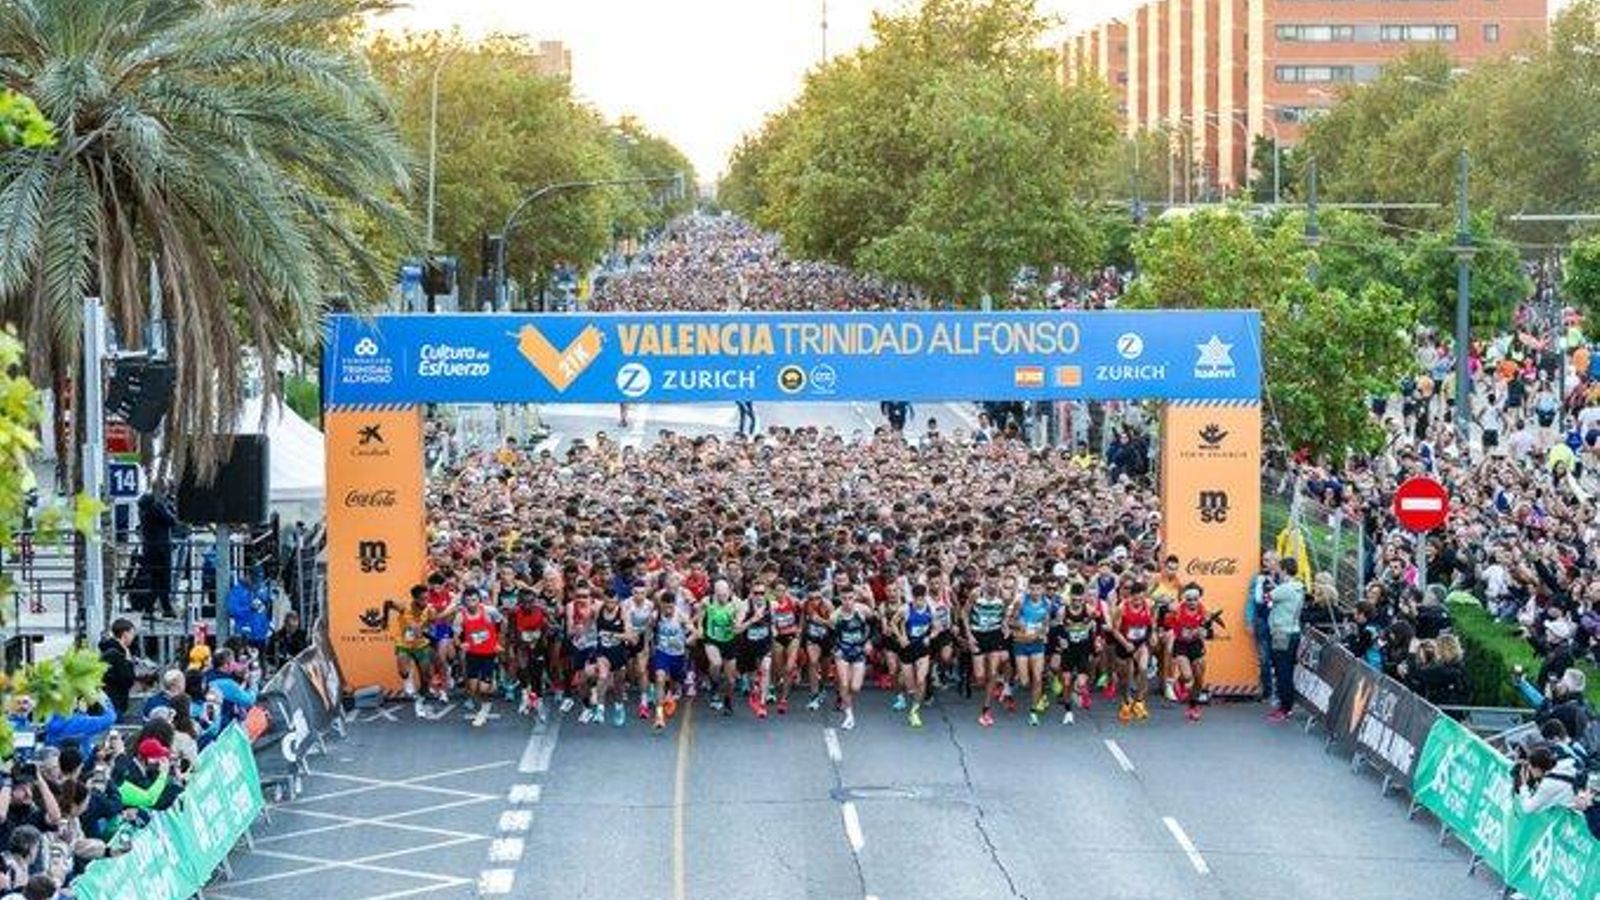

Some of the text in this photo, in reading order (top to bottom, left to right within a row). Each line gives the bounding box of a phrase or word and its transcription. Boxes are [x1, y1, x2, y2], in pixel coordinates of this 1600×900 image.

[617, 321, 1081, 356] VALENCIA TRINIDAD ALFONSO
[420, 344, 475, 360] Cultura
[559, 341, 589, 379] 21K
[342, 365, 393, 374] TRINIDAD
[418, 360, 490, 376] Esfuerzo
[1095, 365, 1166, 380] ZURICH
[342, 374, 393, 384] ALFONSO
[662, 369, 756, 390] ZURICH
[113, 469, 137, 492] 14
